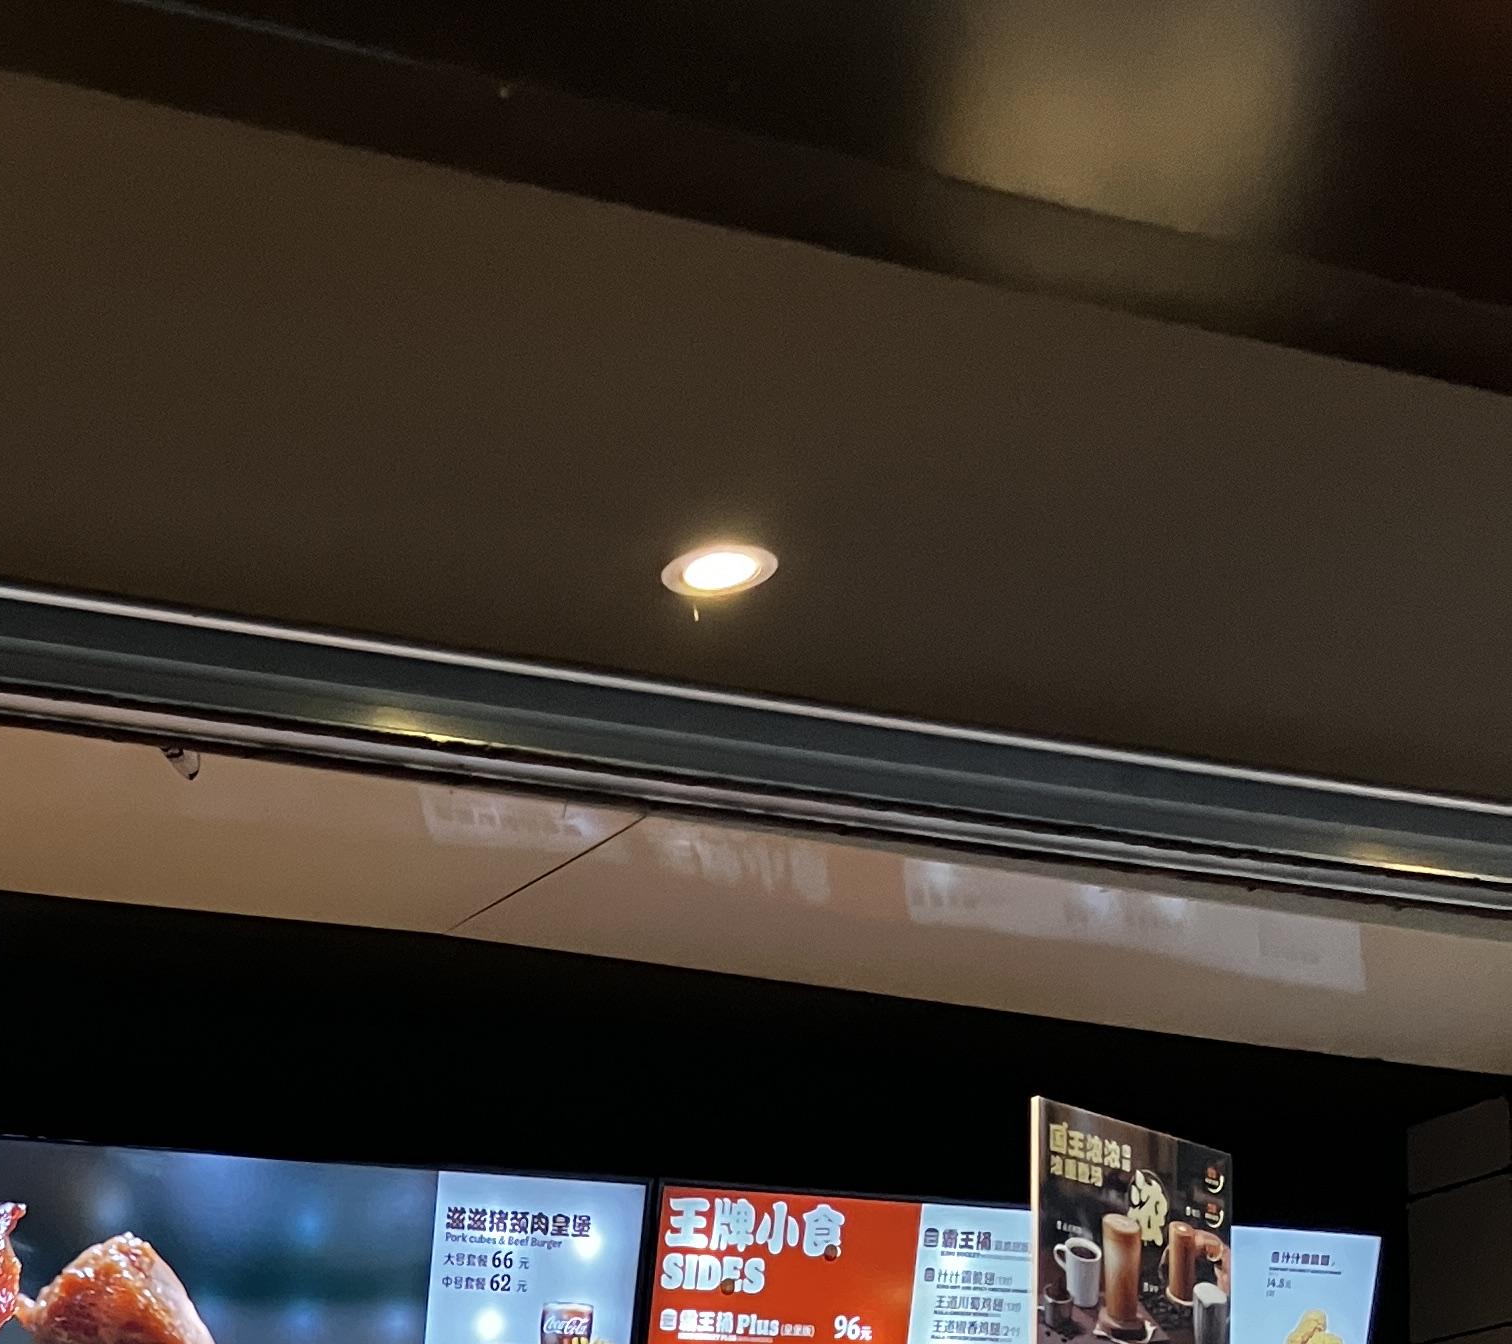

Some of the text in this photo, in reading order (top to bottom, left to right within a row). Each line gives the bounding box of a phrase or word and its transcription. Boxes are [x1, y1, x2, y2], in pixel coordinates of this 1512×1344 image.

[446, 1206, 591, 1238] 滋滋猪颈肉皇堡
[665, 1197, 845, 1257] 王牌小食
[445, 1232, 467, 1243] Pork
[469, 1234, 497, 1245] cubes
[507, 1236, 529, 1247] Beef
[530, 1237, 562, 1250] Burger
[492, 1250, 513, 1269] 66
[518, 1256, 530, 1270] 元
[660, 1253, 765, 1294] SIDES
[490, 1274, 511, 1292] 62
[516, 1280, 528, 1293] 元
[736, 1313, 780, 1337] Plus
[833, 1315, 872, 1341] 96元
